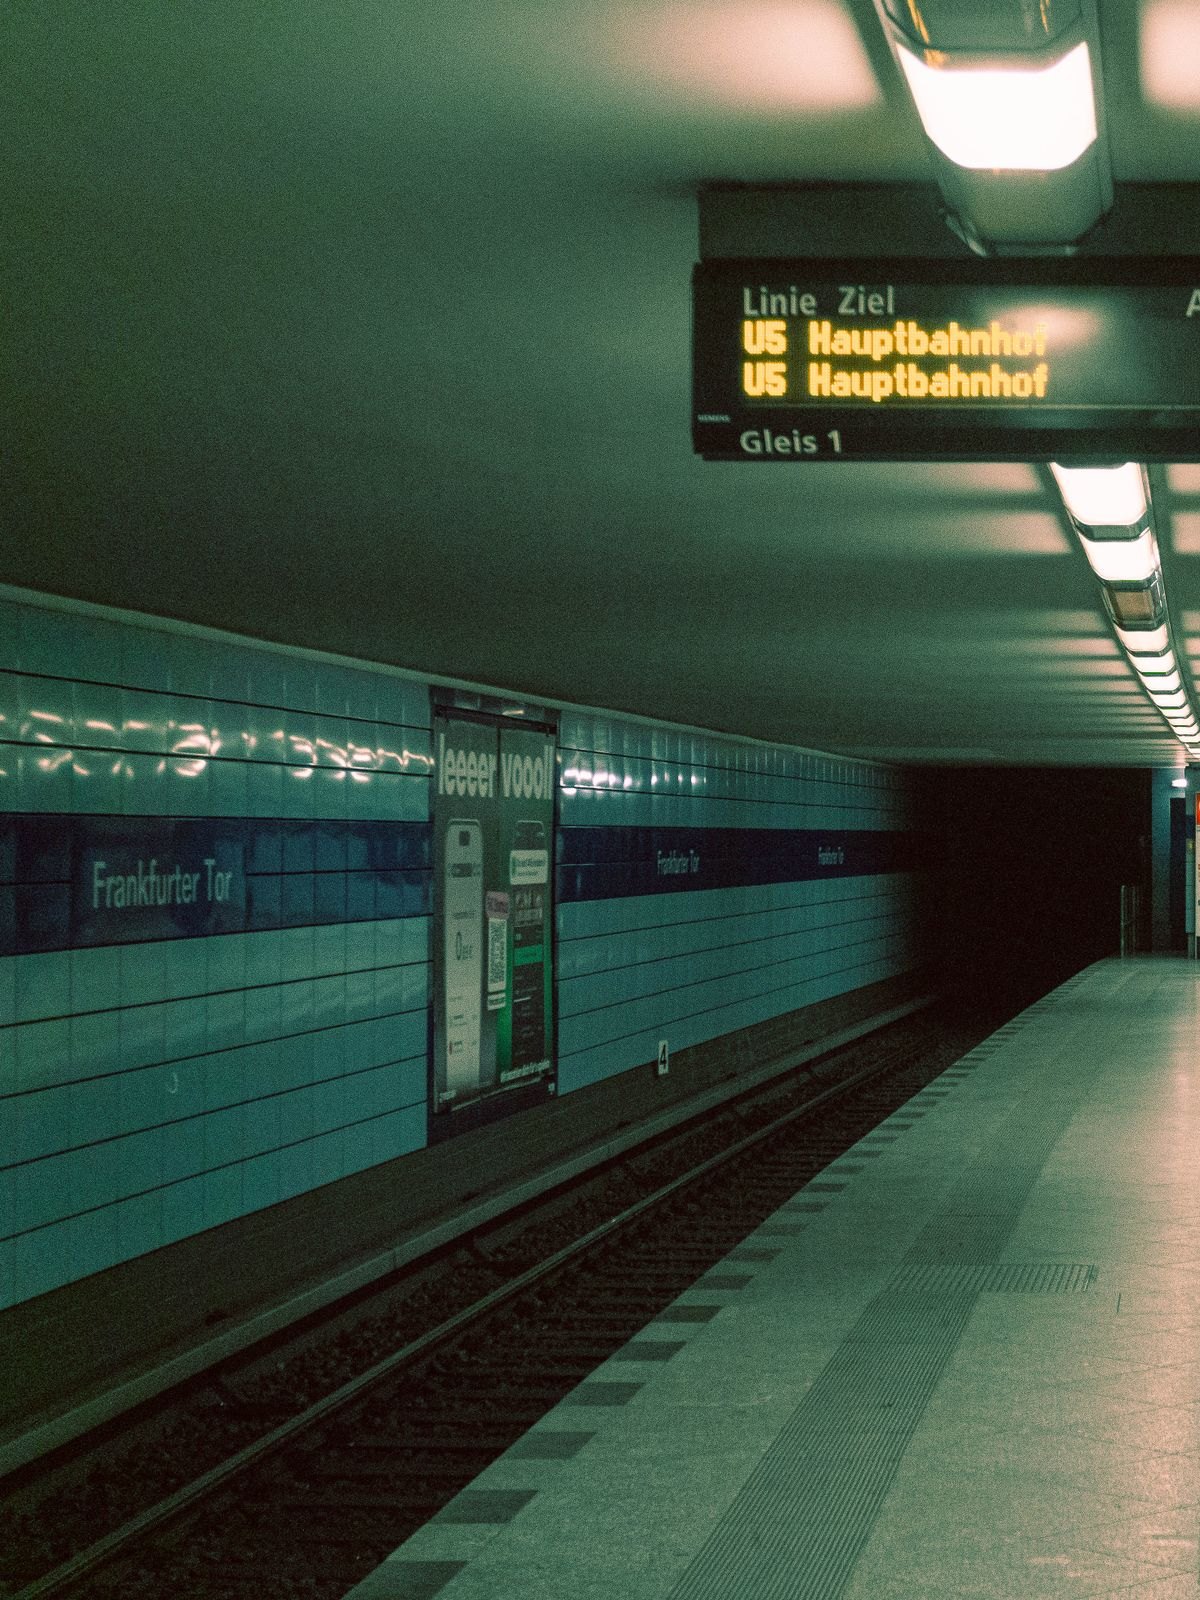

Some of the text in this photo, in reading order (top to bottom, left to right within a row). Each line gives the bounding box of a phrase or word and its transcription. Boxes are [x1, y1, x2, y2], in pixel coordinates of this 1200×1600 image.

[744, 286, 816, 315] Linie
[838, 285, 894, 315] Ziel
[744, 320, 787, 355] U5
[809, 320, 1047, 361] Hauptbahnhof
[744, 362, 787, 396] U5
[809, 362, 1048, 402] Hauptbahnhof
[740, 428, 842, 453] Gleis 1
[439, 732, 554, 799] leeeer voooll
[93, 858, 233, 908] Frankfurter Tor
[660, 1044, 667, 1069] 4
